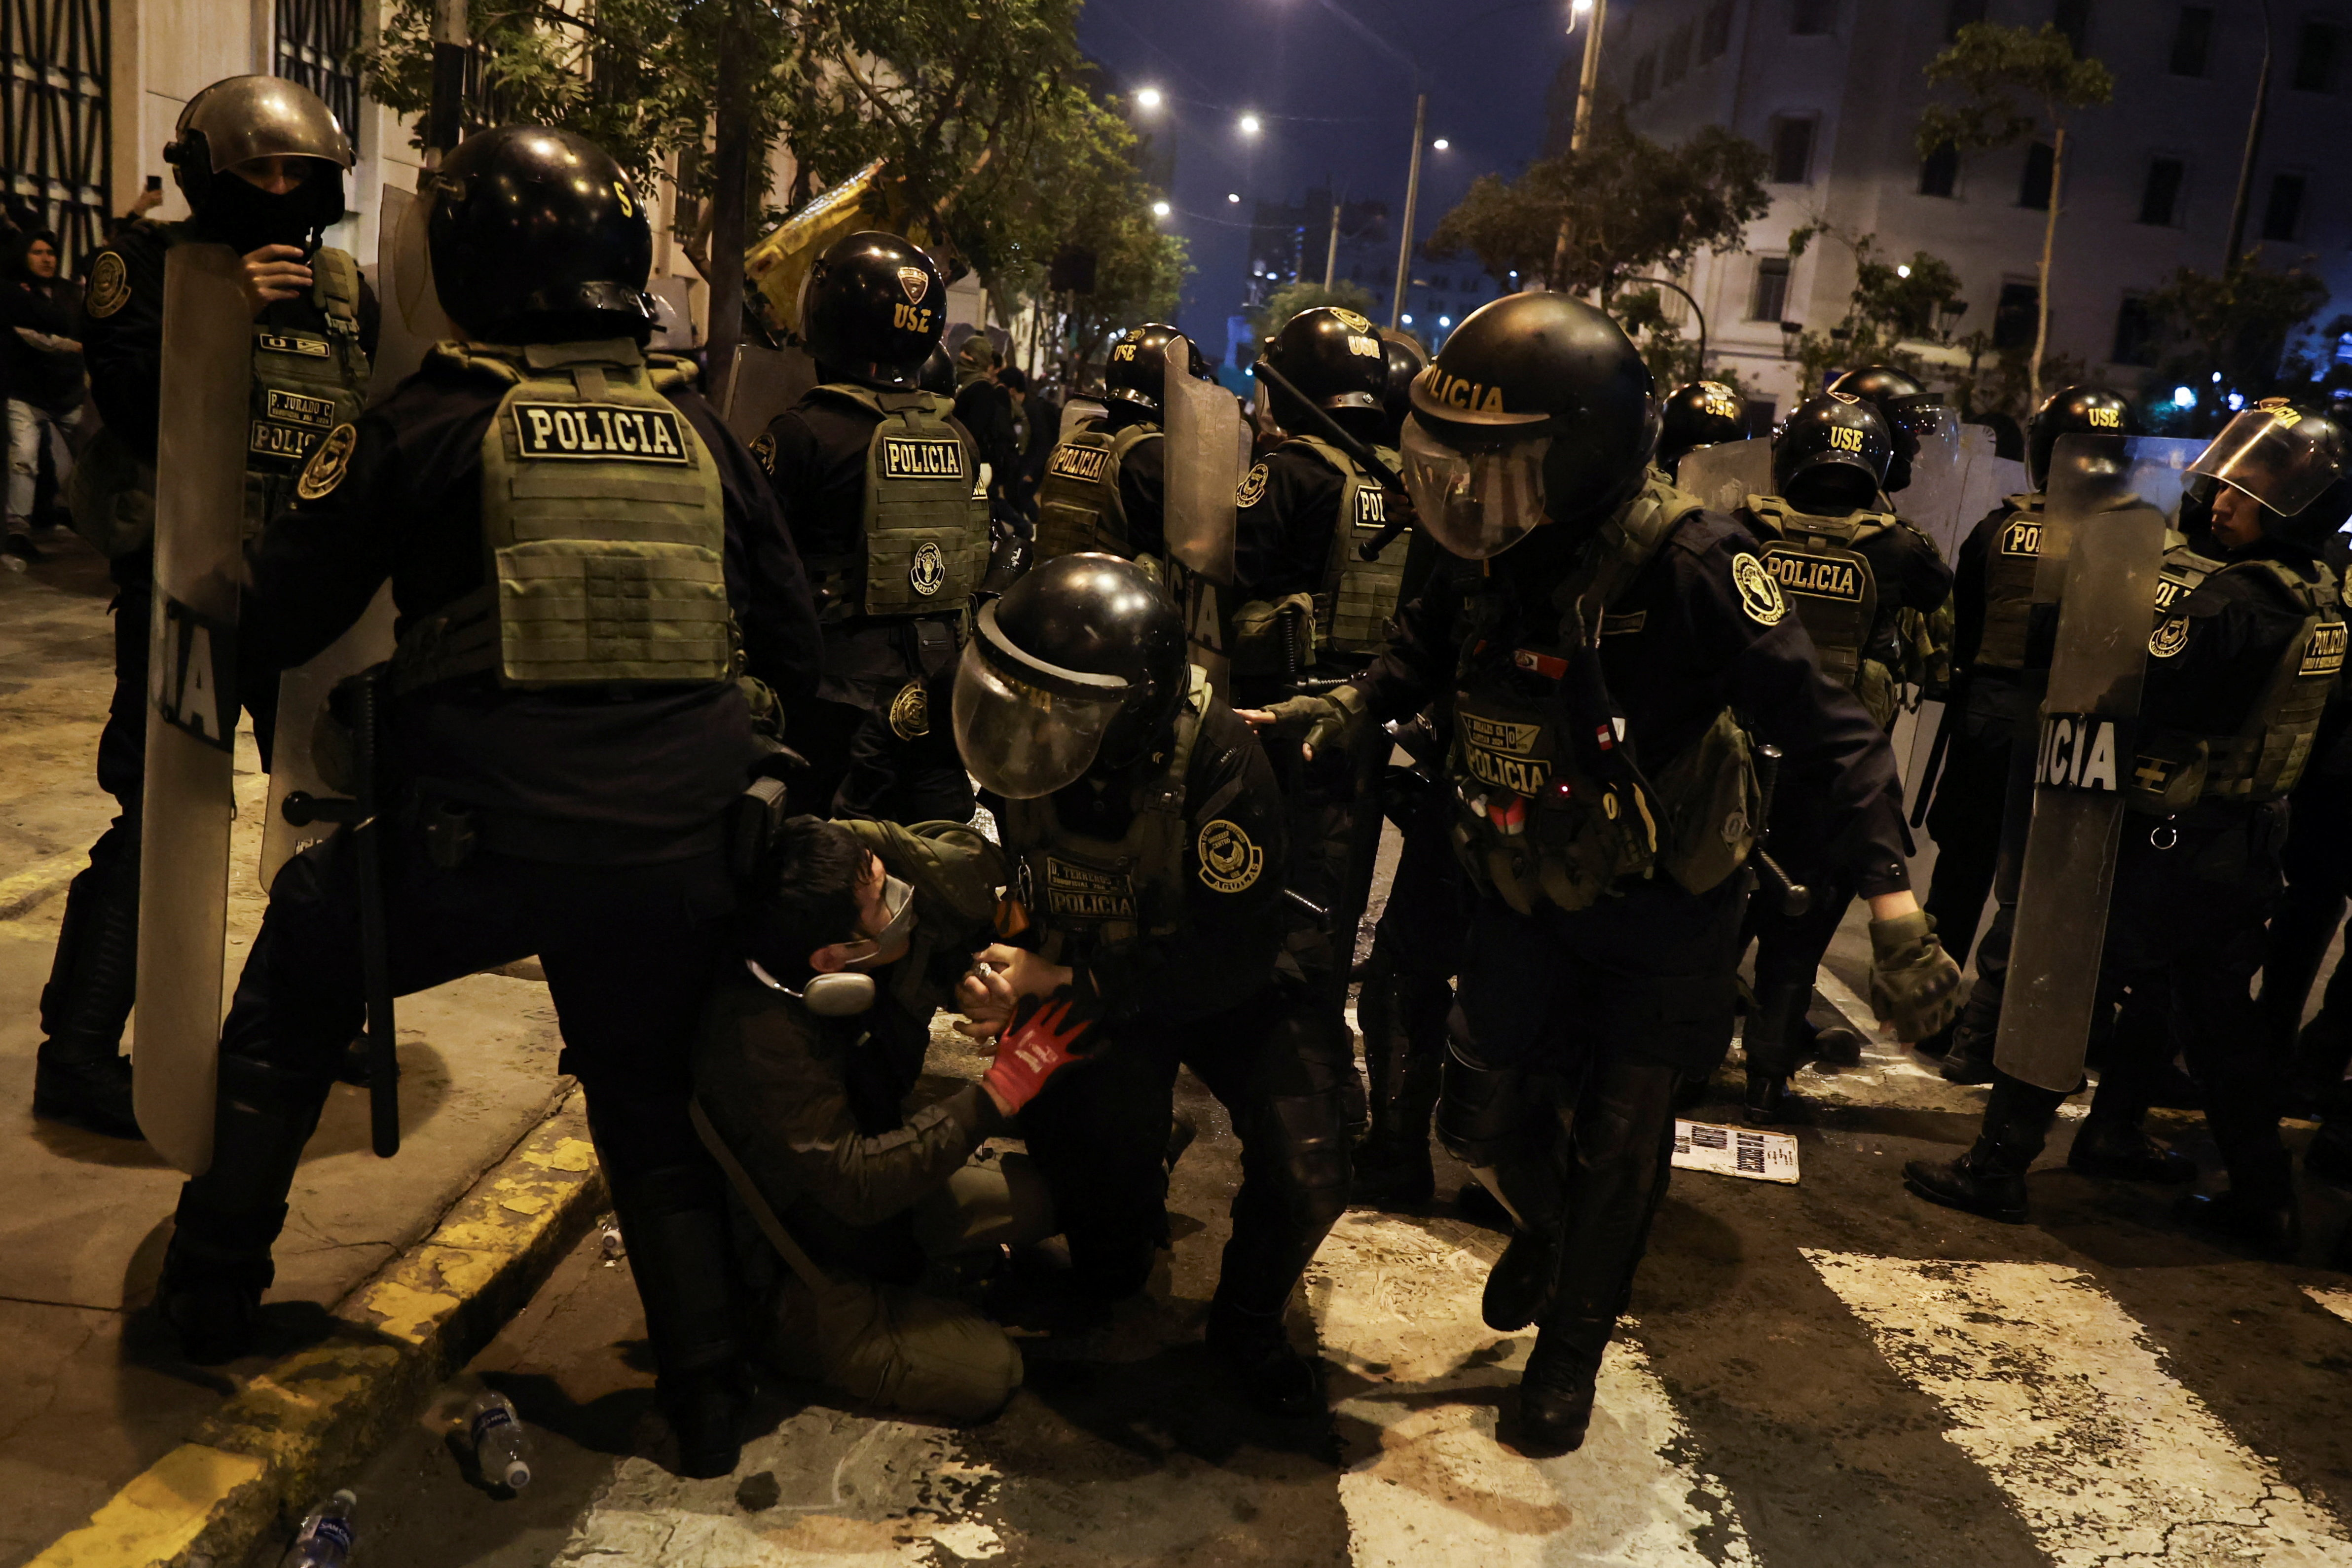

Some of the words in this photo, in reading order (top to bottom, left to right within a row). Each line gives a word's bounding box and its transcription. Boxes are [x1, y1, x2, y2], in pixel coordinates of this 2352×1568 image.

[893, 303, 932, 333] USE
[1114, 344, 1137, 362] USE
[1348, 335, 1381, 360] USE
[285, 396, 320, 415] JURADO
[2088, 408, 2120, 428] USE
[527, 408, 678, 455] POLICIA
[1831, 426, 1864, 453] USE
[888, 443, 959, 474] POLICIA
[1054, 447, 1103, 479] POLICIA
[1767, 557, 1855, 595] POLICIA
[1465, 743, 1545, 794] POLICIA
[1213, 863, 1259, 891] AGUILAS
[1052, 891, 1133, 916] POLICIA
